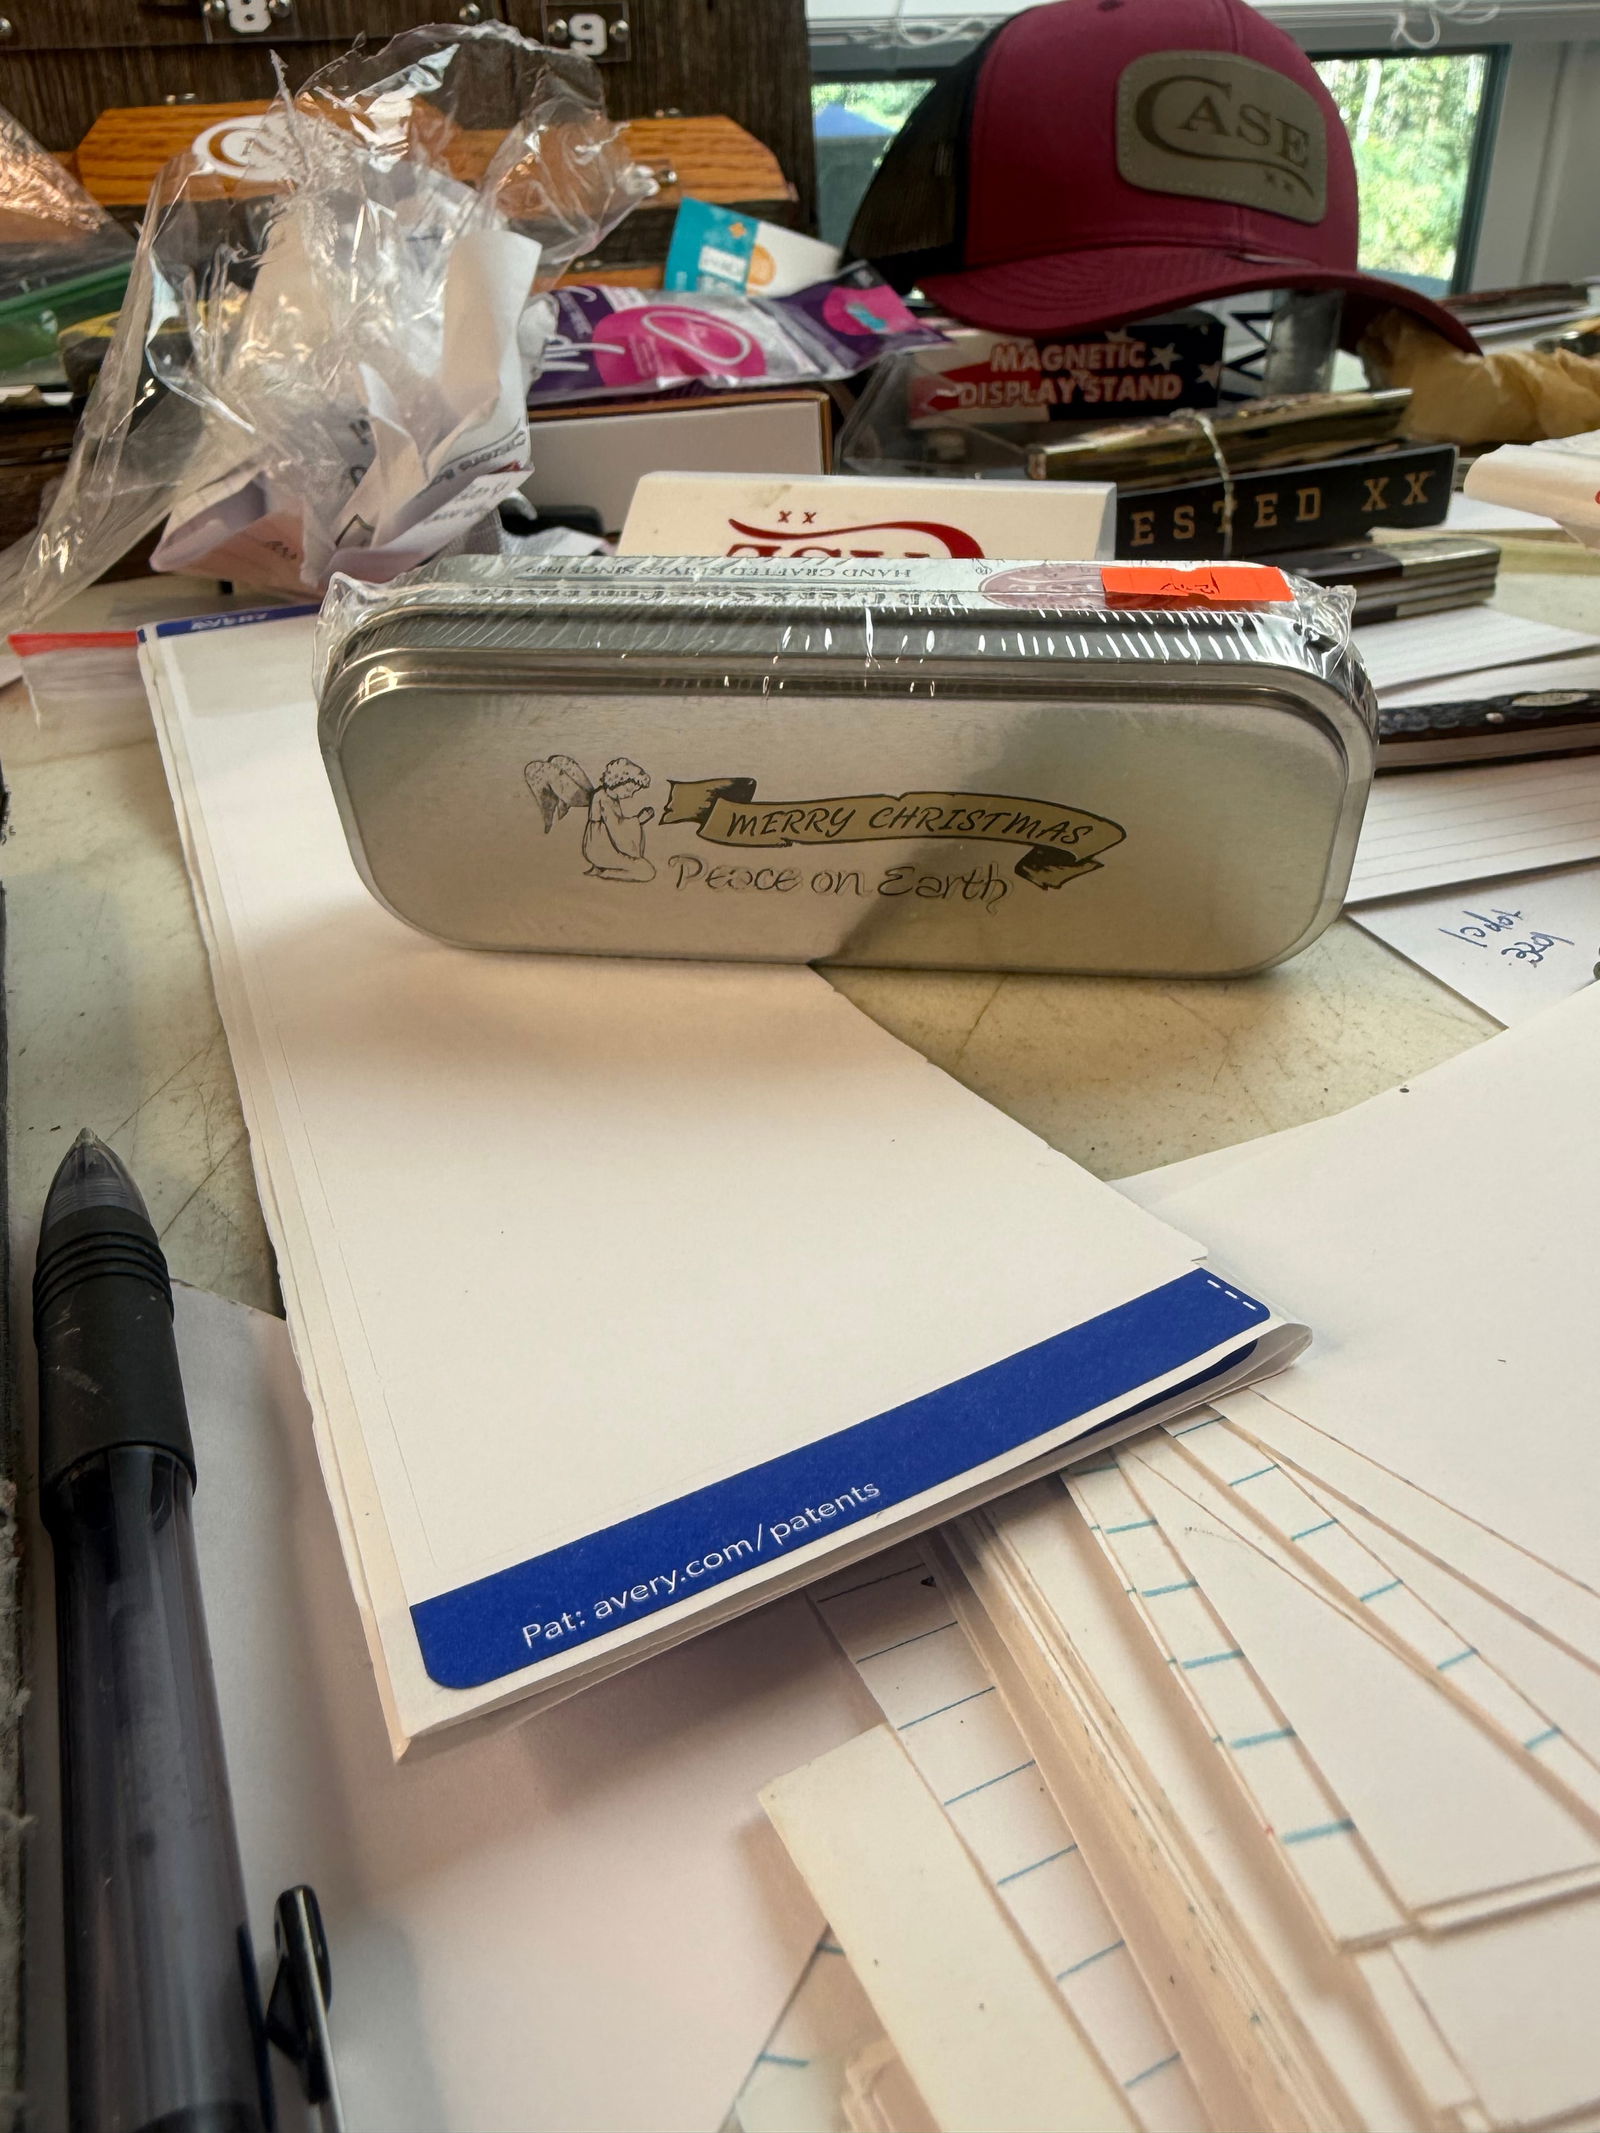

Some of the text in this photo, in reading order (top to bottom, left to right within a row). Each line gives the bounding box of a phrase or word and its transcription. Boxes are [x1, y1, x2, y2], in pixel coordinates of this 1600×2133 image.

[227, 0, 272, 33] 8
[569, 13, 607, 56] 9
[1135, 75, 1313, 190] CASE
[990, 342, 1147, 373] MAGNETIC
[957, 374, 1183, 409] DISPLAY STAND
[1361, 470, 1434, 512] XX
[726, 805, 1094, 845] MERRY CHRISTMAS
[668, 853, 1009, 914] Peace on Earth
[521, 1480, 881, 1649] Pat: avery.com/patents
